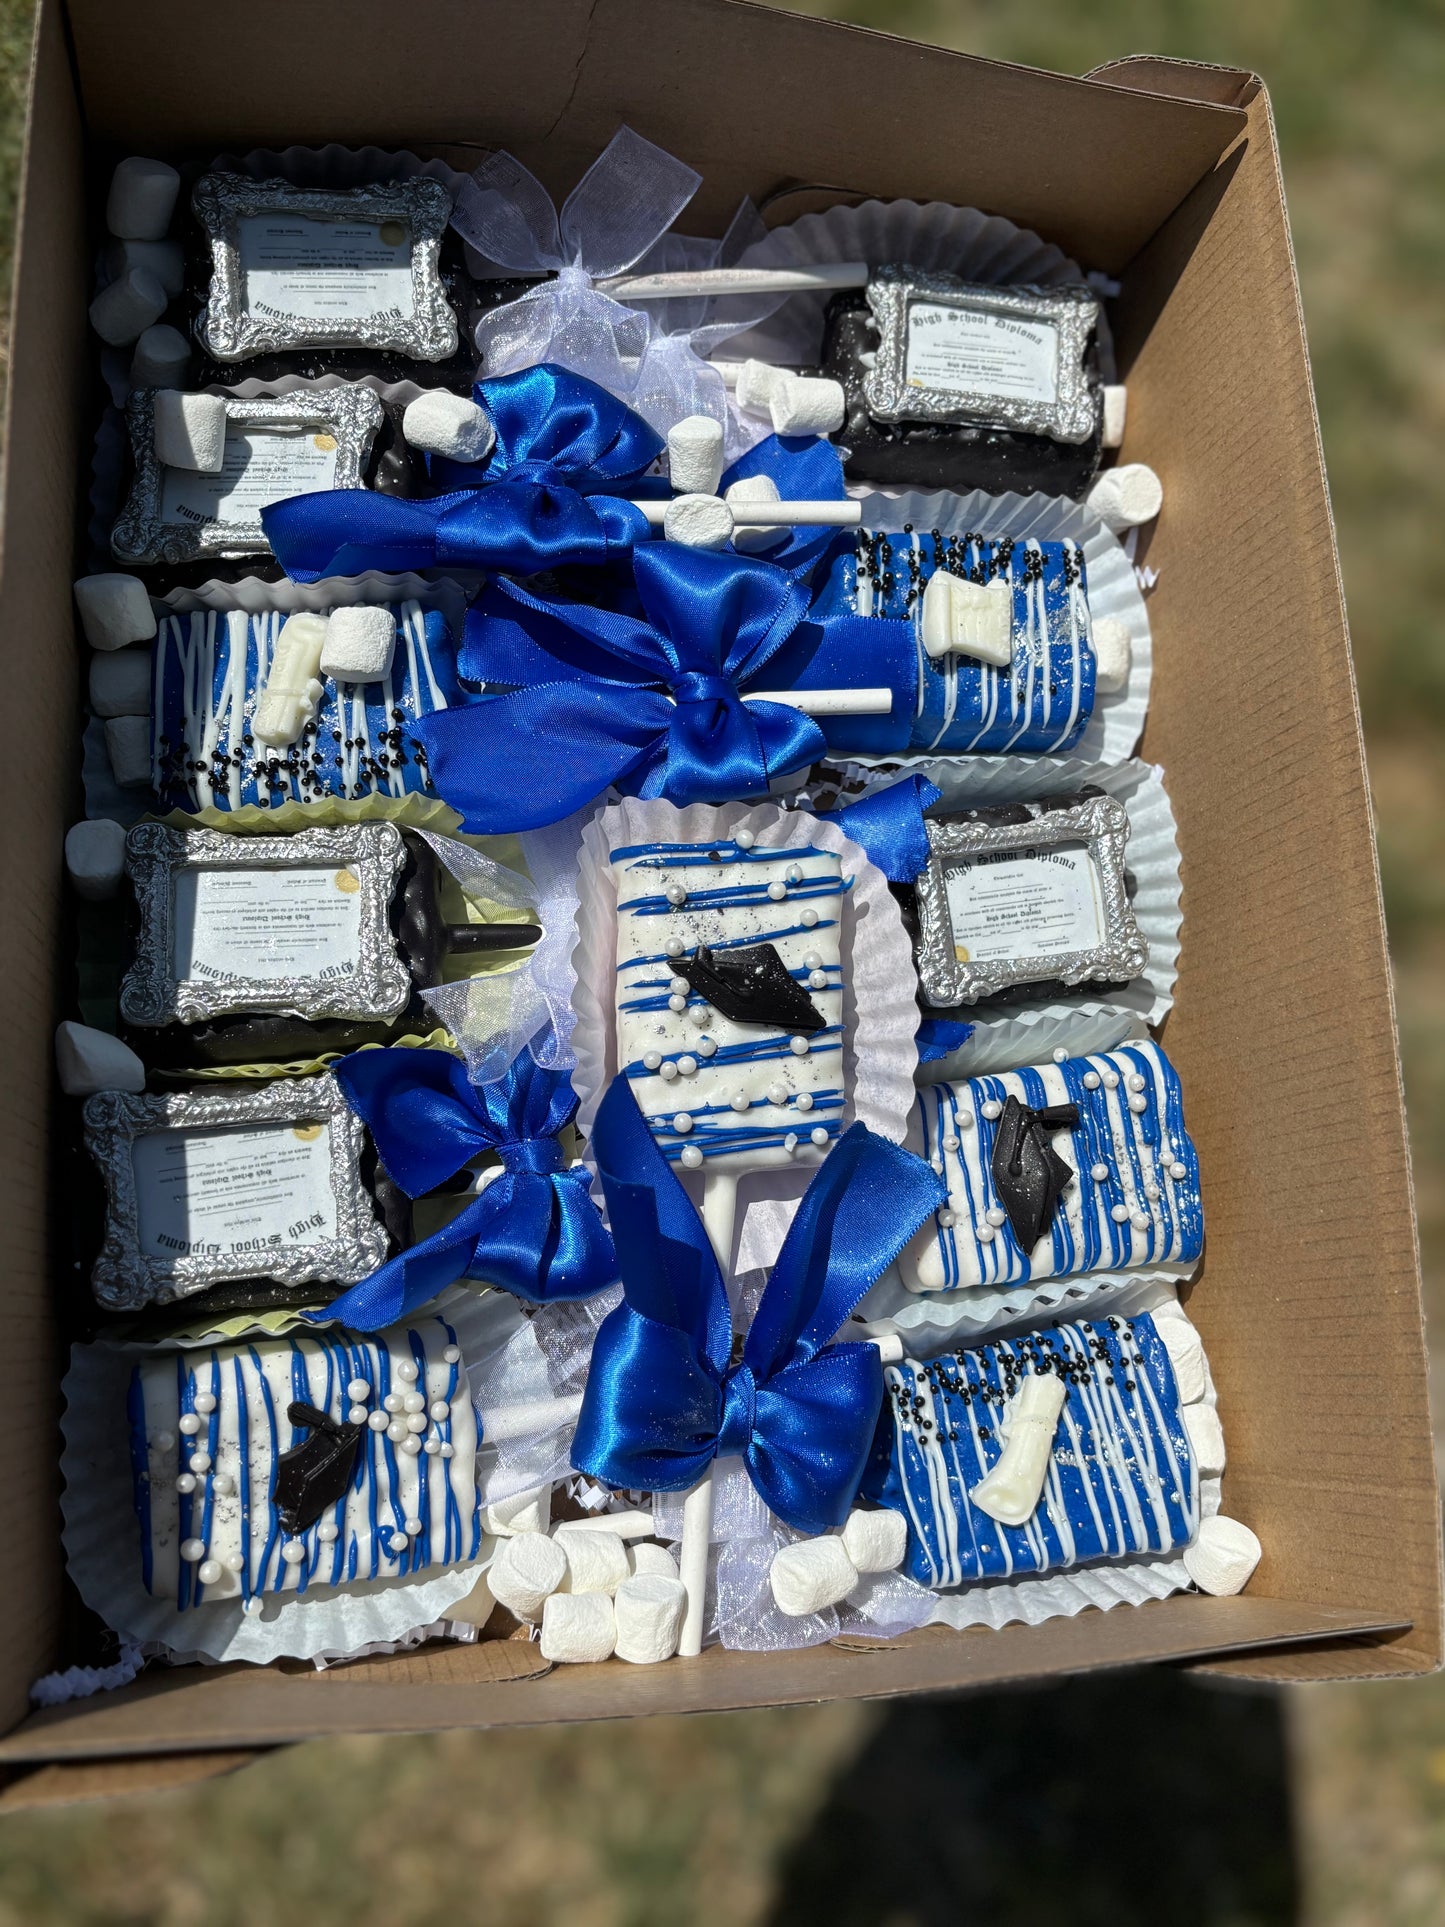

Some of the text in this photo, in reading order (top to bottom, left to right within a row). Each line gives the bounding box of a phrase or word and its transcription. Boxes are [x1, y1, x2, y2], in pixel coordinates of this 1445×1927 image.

[254, 301, 303, 319] iploma
[911, 312, 942, 328] High
[948, 311, 988, 325] School
[995, 319, 1043, 345] Diploma
[175, 504, 220, 525] iploma
[944, 849, 1076, 881] High School Diploma
[288, 1211, 327, 1239] High
[156, 1233, 222, 1256] Diploma
[230, 1233, 282, 1254] School
